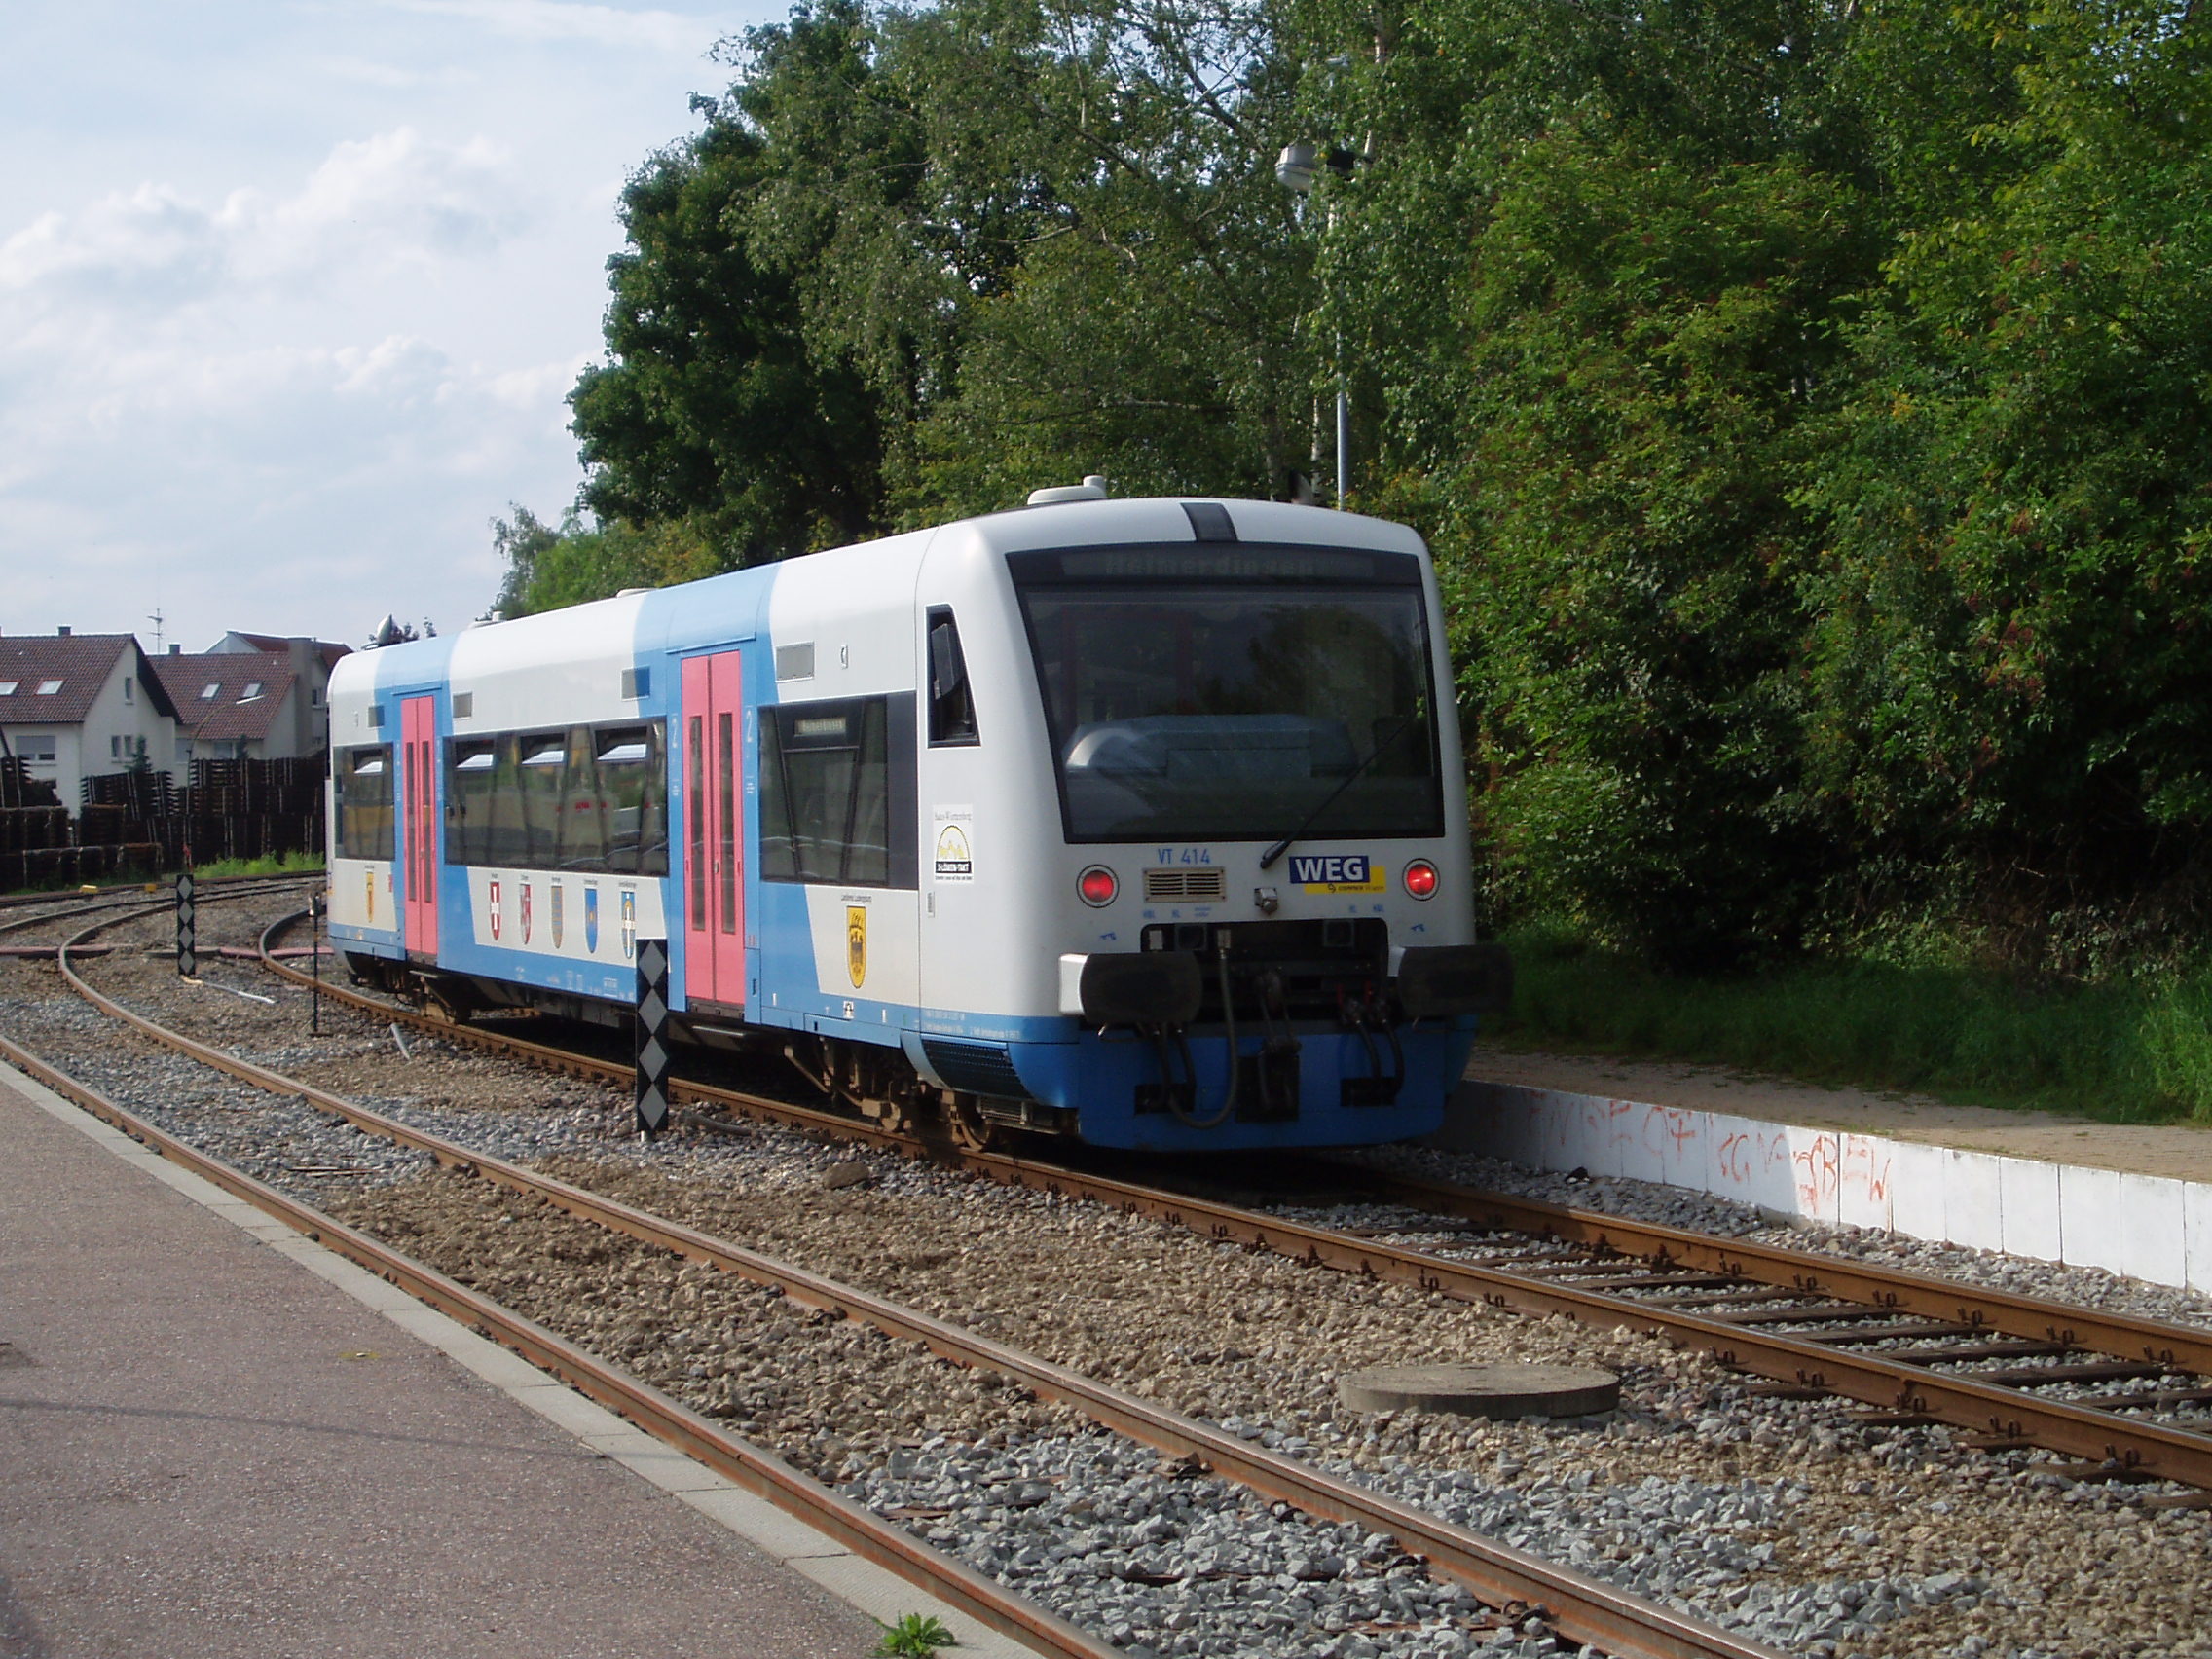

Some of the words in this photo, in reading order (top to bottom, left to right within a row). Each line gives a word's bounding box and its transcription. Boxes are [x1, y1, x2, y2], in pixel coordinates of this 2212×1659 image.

[1158, 848, 1173, 864] VT
[1181, 848, 1211, 865] 414
[1295, 857, 1364, 882] WEG
